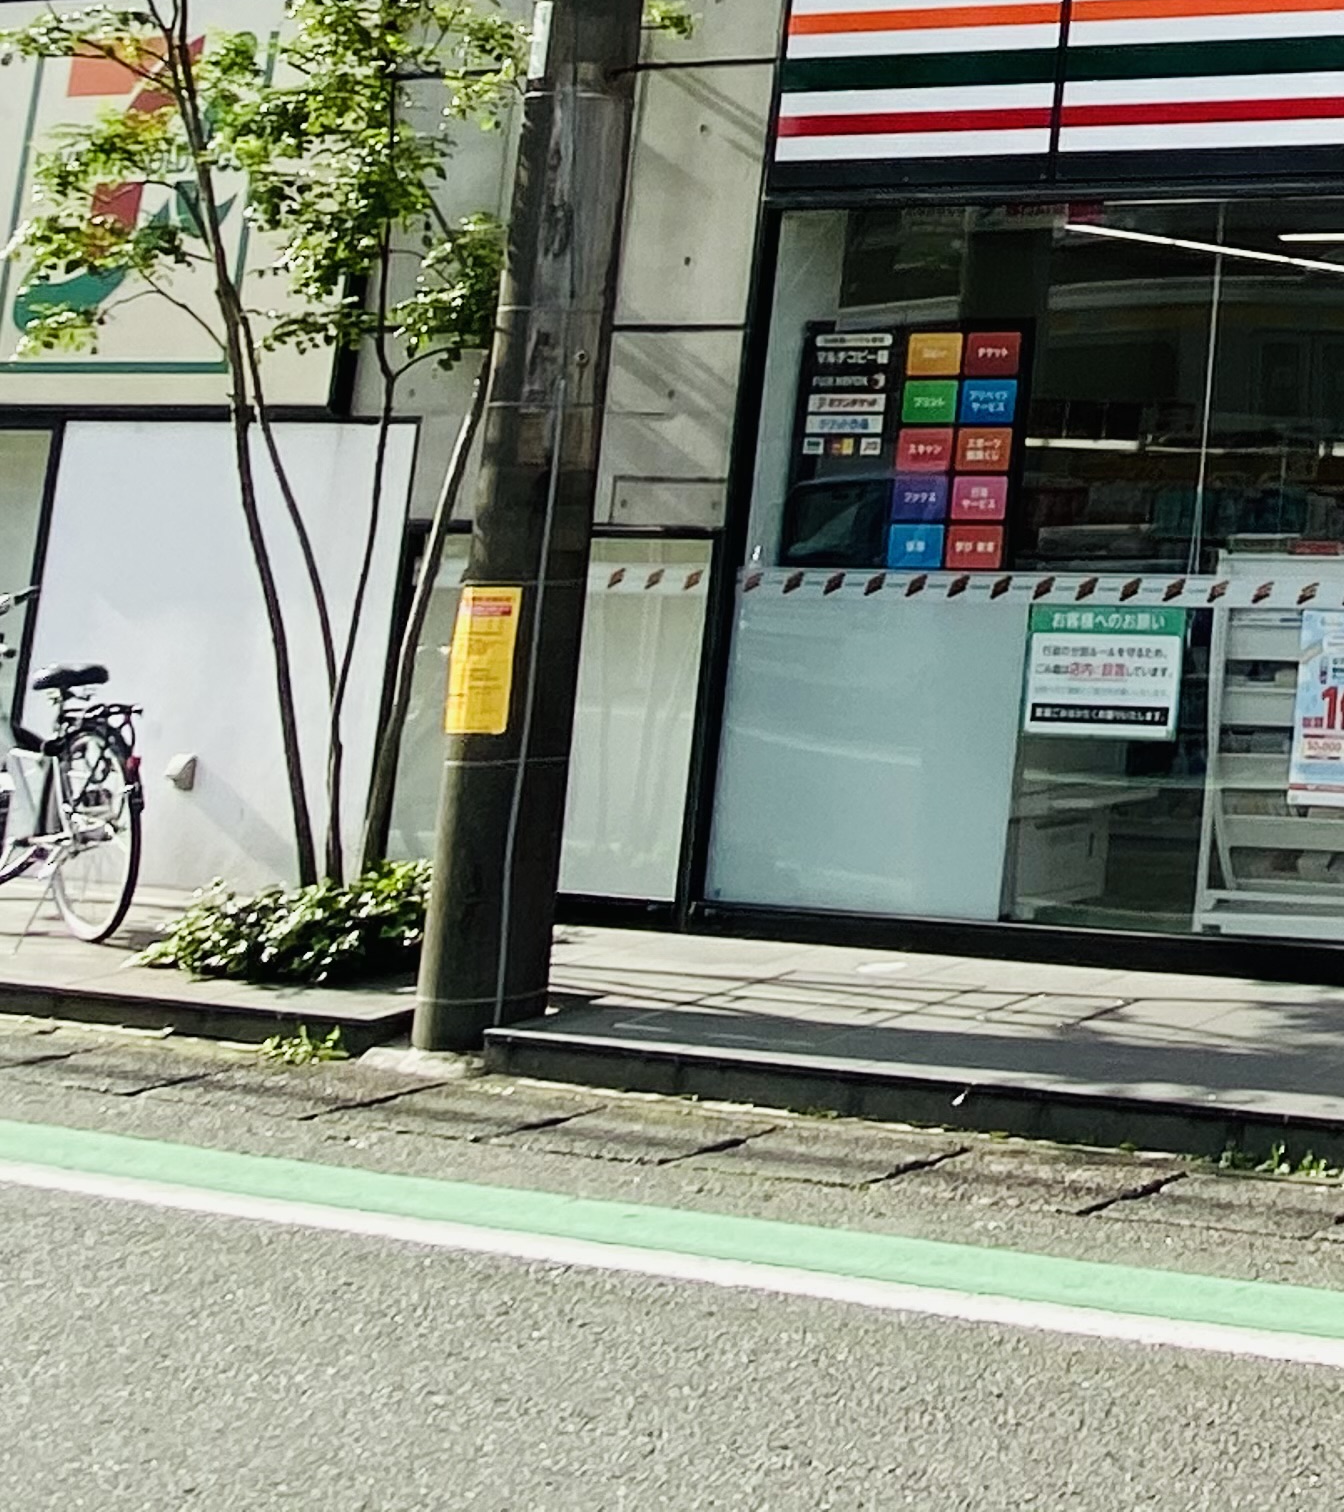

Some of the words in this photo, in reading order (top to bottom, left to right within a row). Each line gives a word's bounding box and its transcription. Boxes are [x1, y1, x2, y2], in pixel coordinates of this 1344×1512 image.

[1052, 612, 1166, 630] お客様へのお願い
